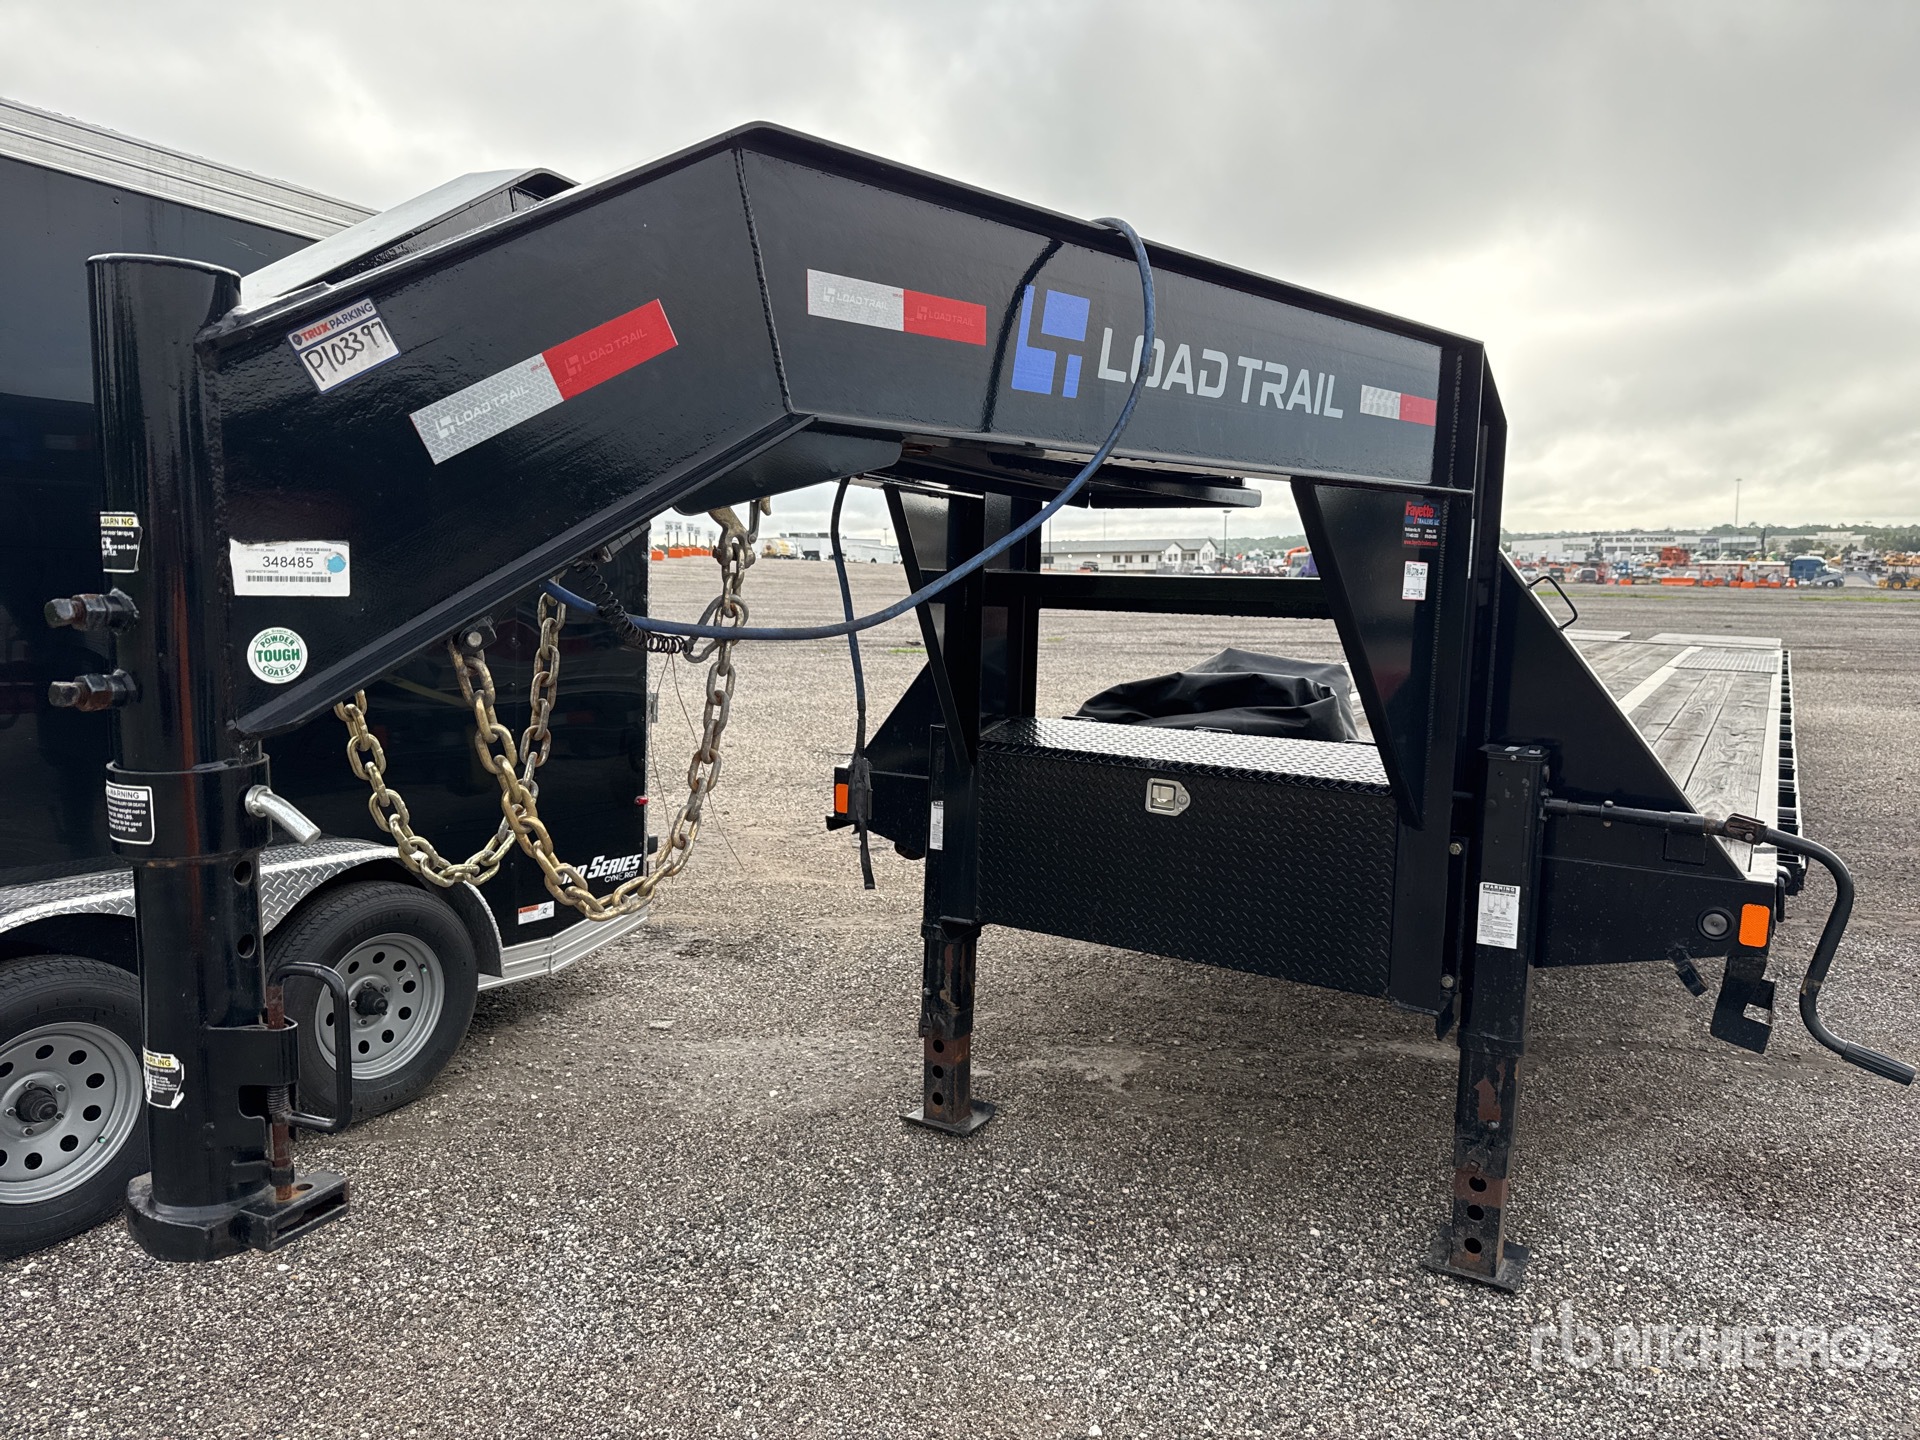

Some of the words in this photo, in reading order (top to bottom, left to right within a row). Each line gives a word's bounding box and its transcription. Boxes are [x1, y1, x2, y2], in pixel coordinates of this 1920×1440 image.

[837, 292, 863, 305] LOAD
[863, 298, 889, 310] TRAIL
[928, 311, 951, 321] LOAD
[951, 315, 975, 327] TRAIL
[582, 342, 614, 366] LOAD
[613, 328, 647, 348] TRAIL
[1097, 327, 1229, 399] LOAD
[1237, 355, 1344, 419] TRAIL
[455, 399, 491, 428] LOAD
[491, 384, 530, 407] TRAIL
[1405, 501, 1434, 525] Fayette
[262, 556, 314, 568] 348485
[260, 635, 296, 648] POWDER
[255, 648, 300, 663] TOUGH
[262, 663, 297, 676] COATED
[587, 853, 642, 879] SERIES
[604, 870, 638, 883] CYNERGY
[1483, 884, 1515, 892] WARNING
